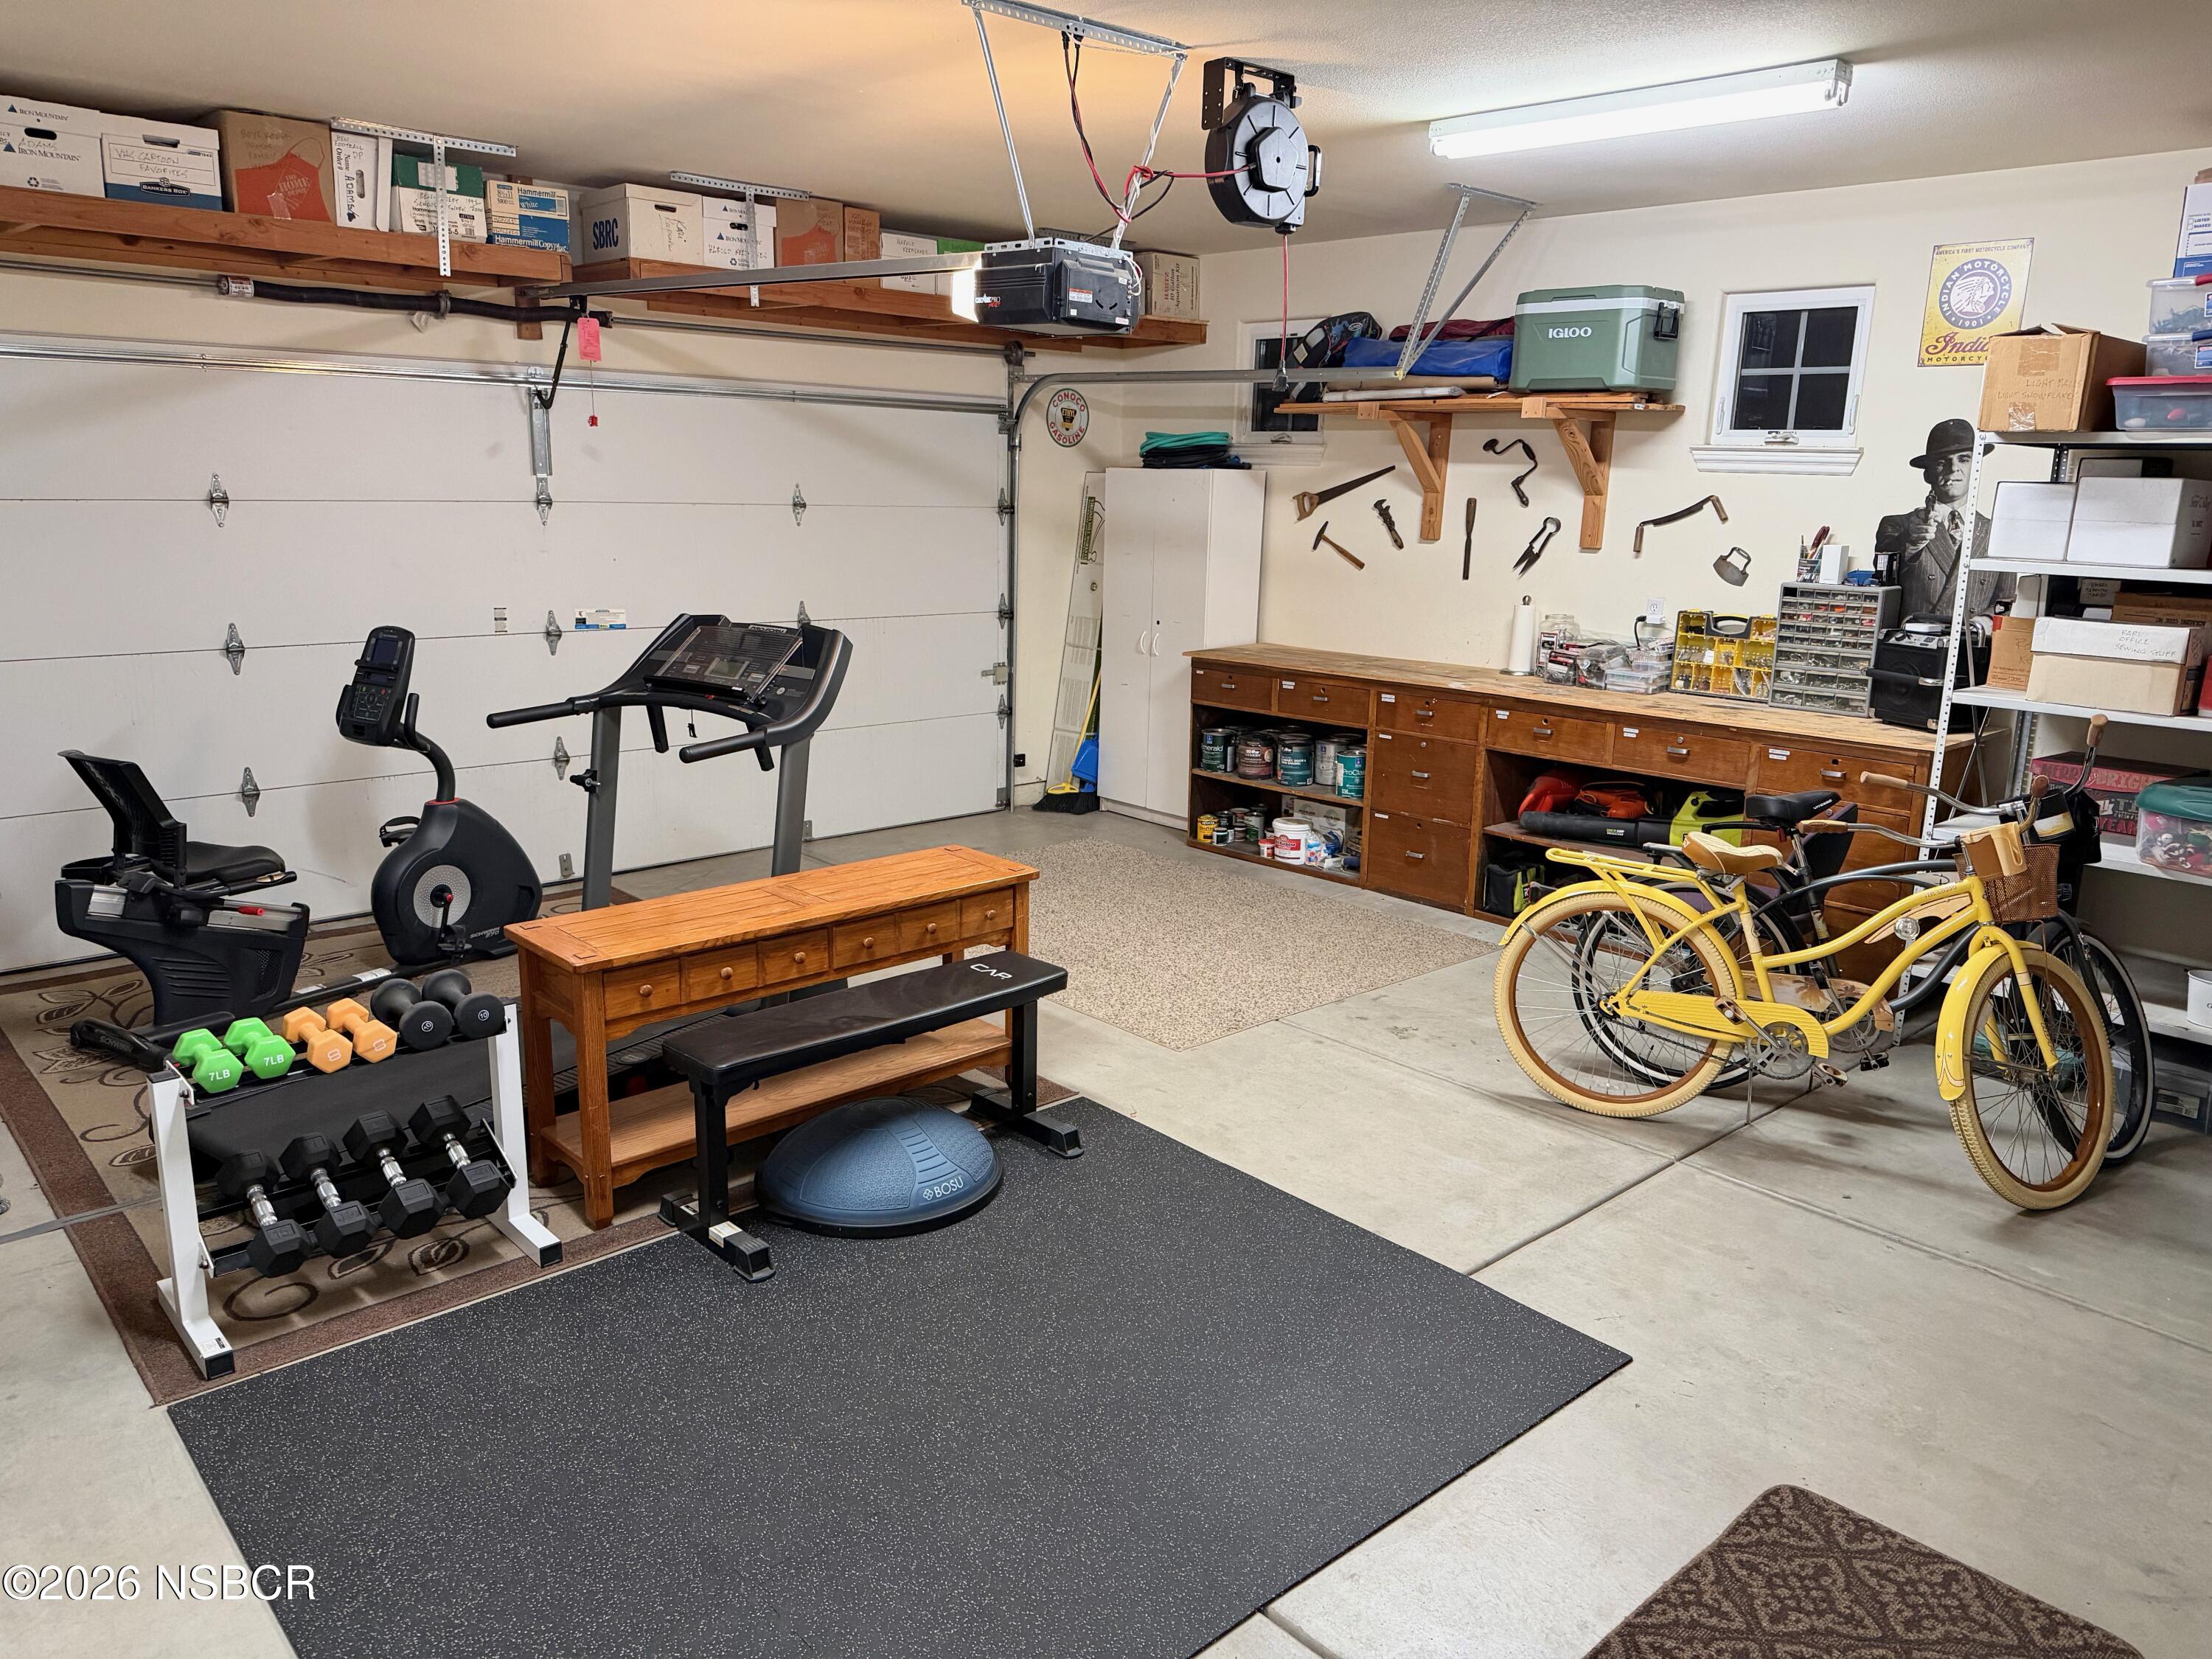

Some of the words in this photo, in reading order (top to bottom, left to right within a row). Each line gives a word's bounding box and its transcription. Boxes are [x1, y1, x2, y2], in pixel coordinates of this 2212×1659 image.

[18, 147, 38, 156] IRON
[38, 150, 81, 161] MOUNTAIN
[142, 184, 173, 193] BANKERS
[517, 187, 556, 198] Hammermill
[495, 234, 539, 248] Hammermill
[593, 218, 619, 250] SBRC
[1975, 246, 2006, 254] MOTORCYCLE
[1941, 271, 1961, 316] INDIAN
[1963, 260, 2011, 315] MOTORCYCLE
[1958, 319, 1984, 327] 1901
[1548, 327, 1592, 339] IGLOO
[1052, 392, 1085, 412] CONOCO
[1050, 421, 1085, 444] GASOLINE
[970, 963, 1013, 980] CAP
[263, 1054, 285, 1067] 7LB
[209, 1069, 231, 1082] 7LB
[933, 1176, 964, 1197] BOSU
